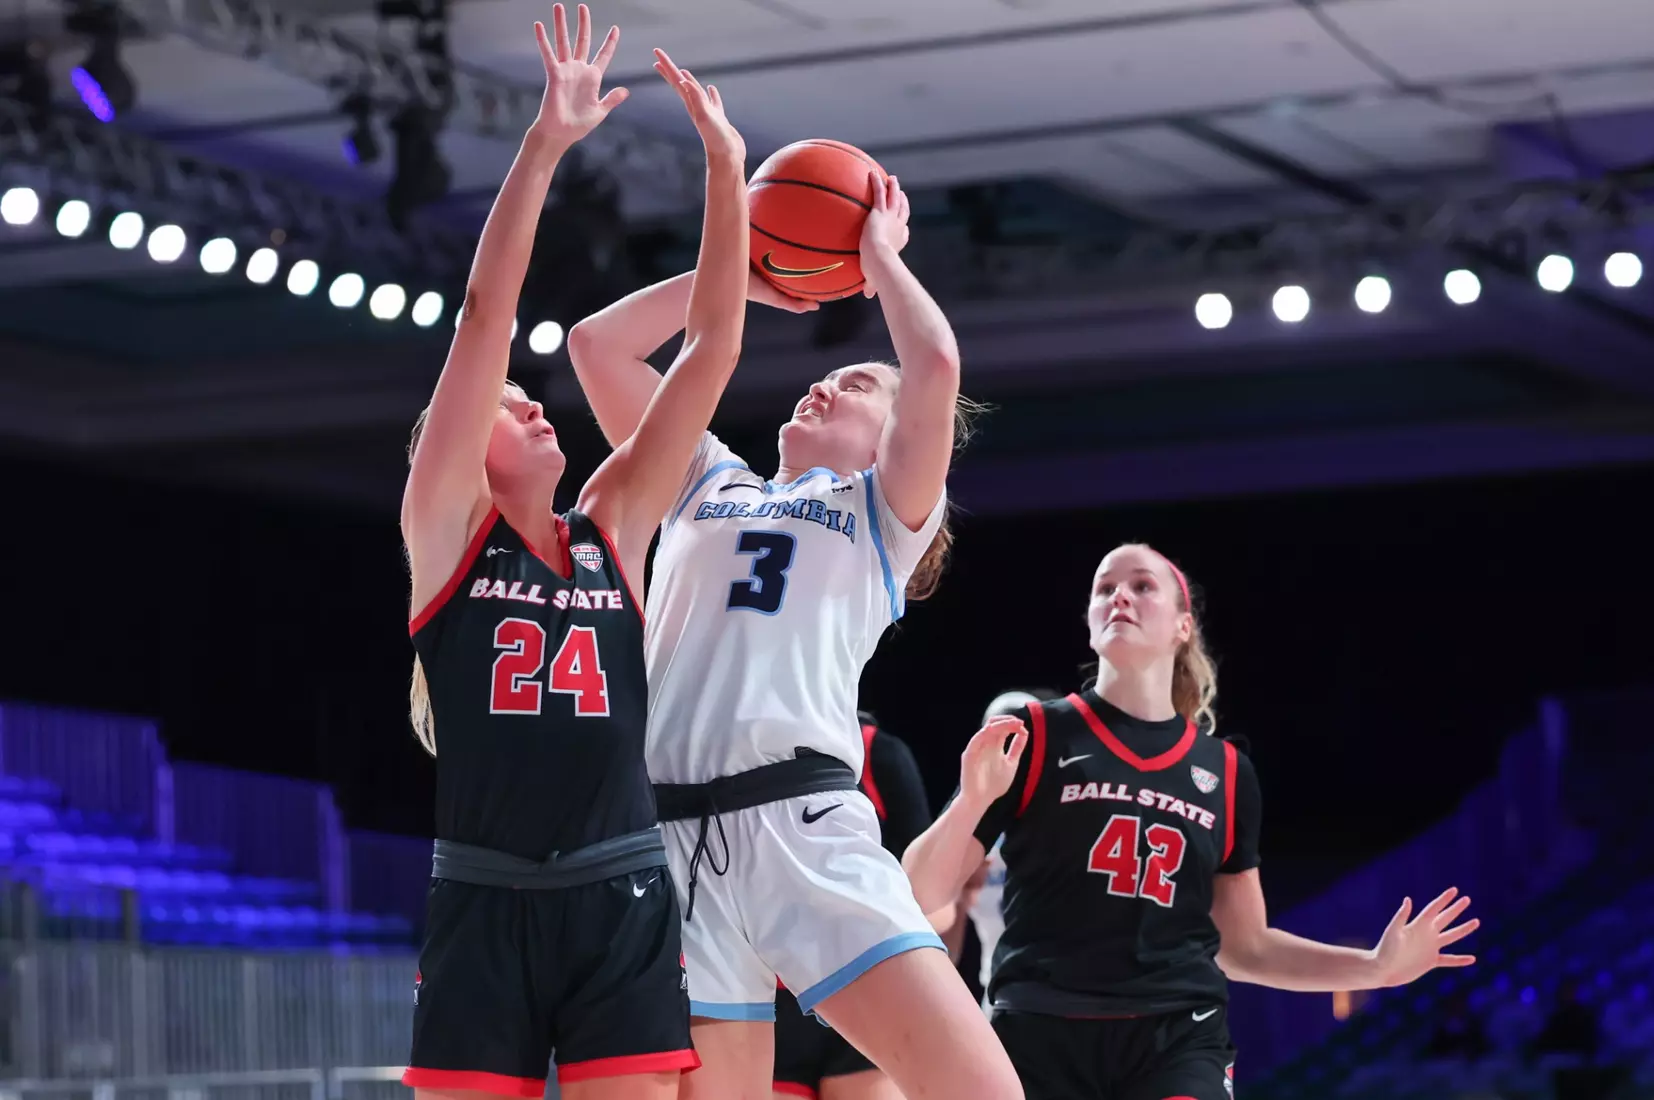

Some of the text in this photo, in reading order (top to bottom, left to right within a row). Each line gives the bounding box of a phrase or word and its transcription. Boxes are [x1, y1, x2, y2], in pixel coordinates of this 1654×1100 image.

[693, 498, 857, 544] COLUMBIA
[575, 552, 603, 561] MAC
[726, 530, 798, 616] 3
[469, 577, 624, 610] BALL STATE
[489, 617, 610, 717] 24
[1060, 782, 1216, 830] BALL STATE
[1087, 814, 1187, 908] 42
